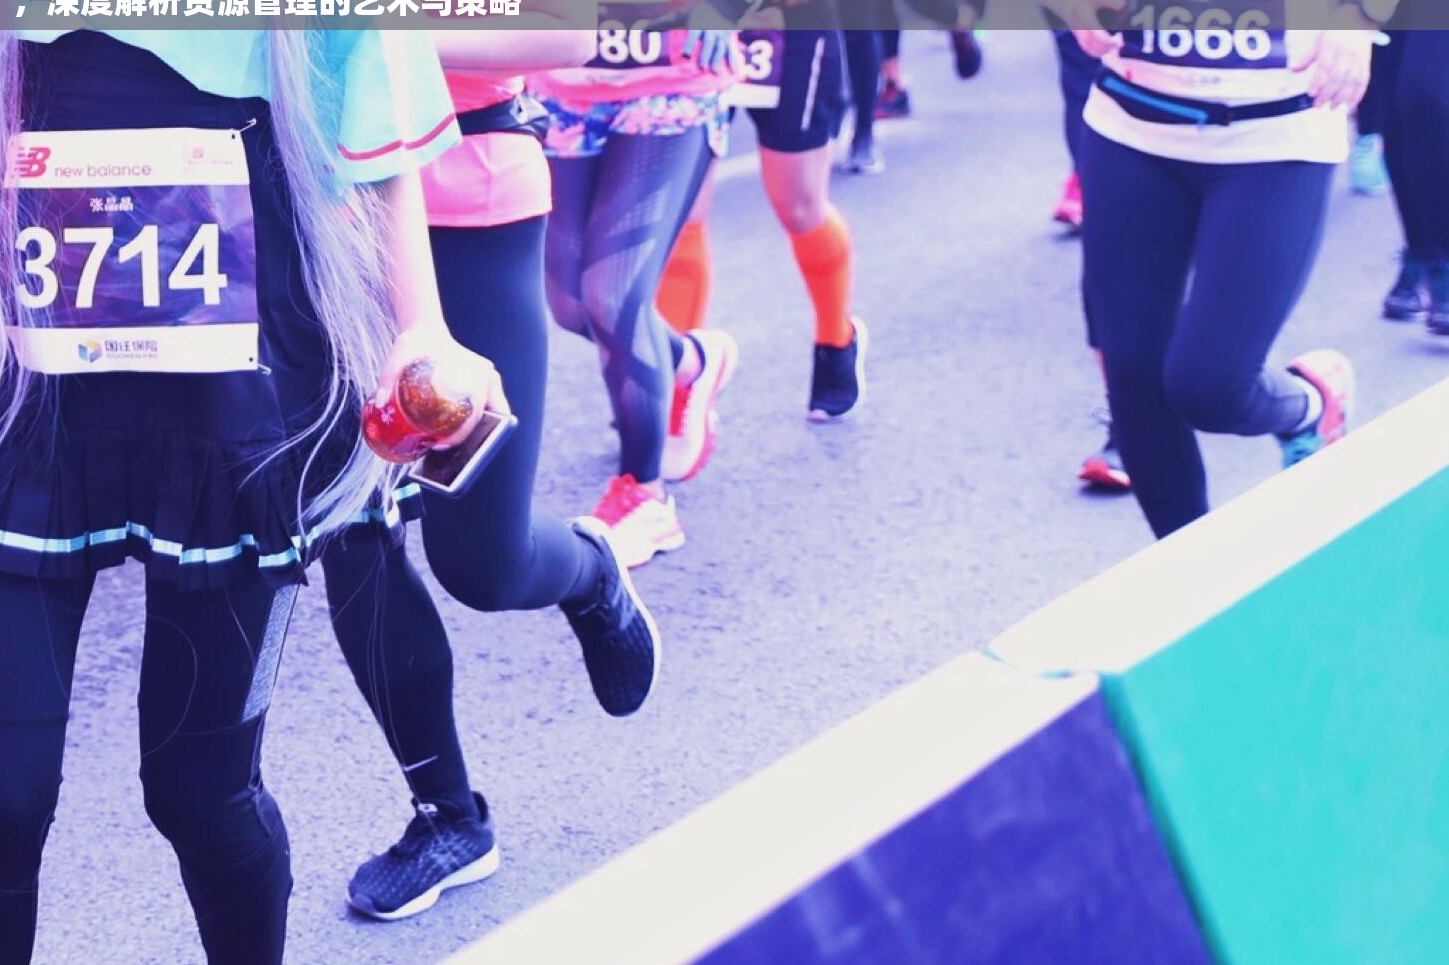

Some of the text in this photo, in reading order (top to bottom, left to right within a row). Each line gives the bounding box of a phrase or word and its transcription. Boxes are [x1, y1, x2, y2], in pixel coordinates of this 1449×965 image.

[1131, 5, 1272, 61] 1666
[54, 165, 83, 177] new
[87, 162, 151, 177] balance
[15, 223, 228, 309] 3714
